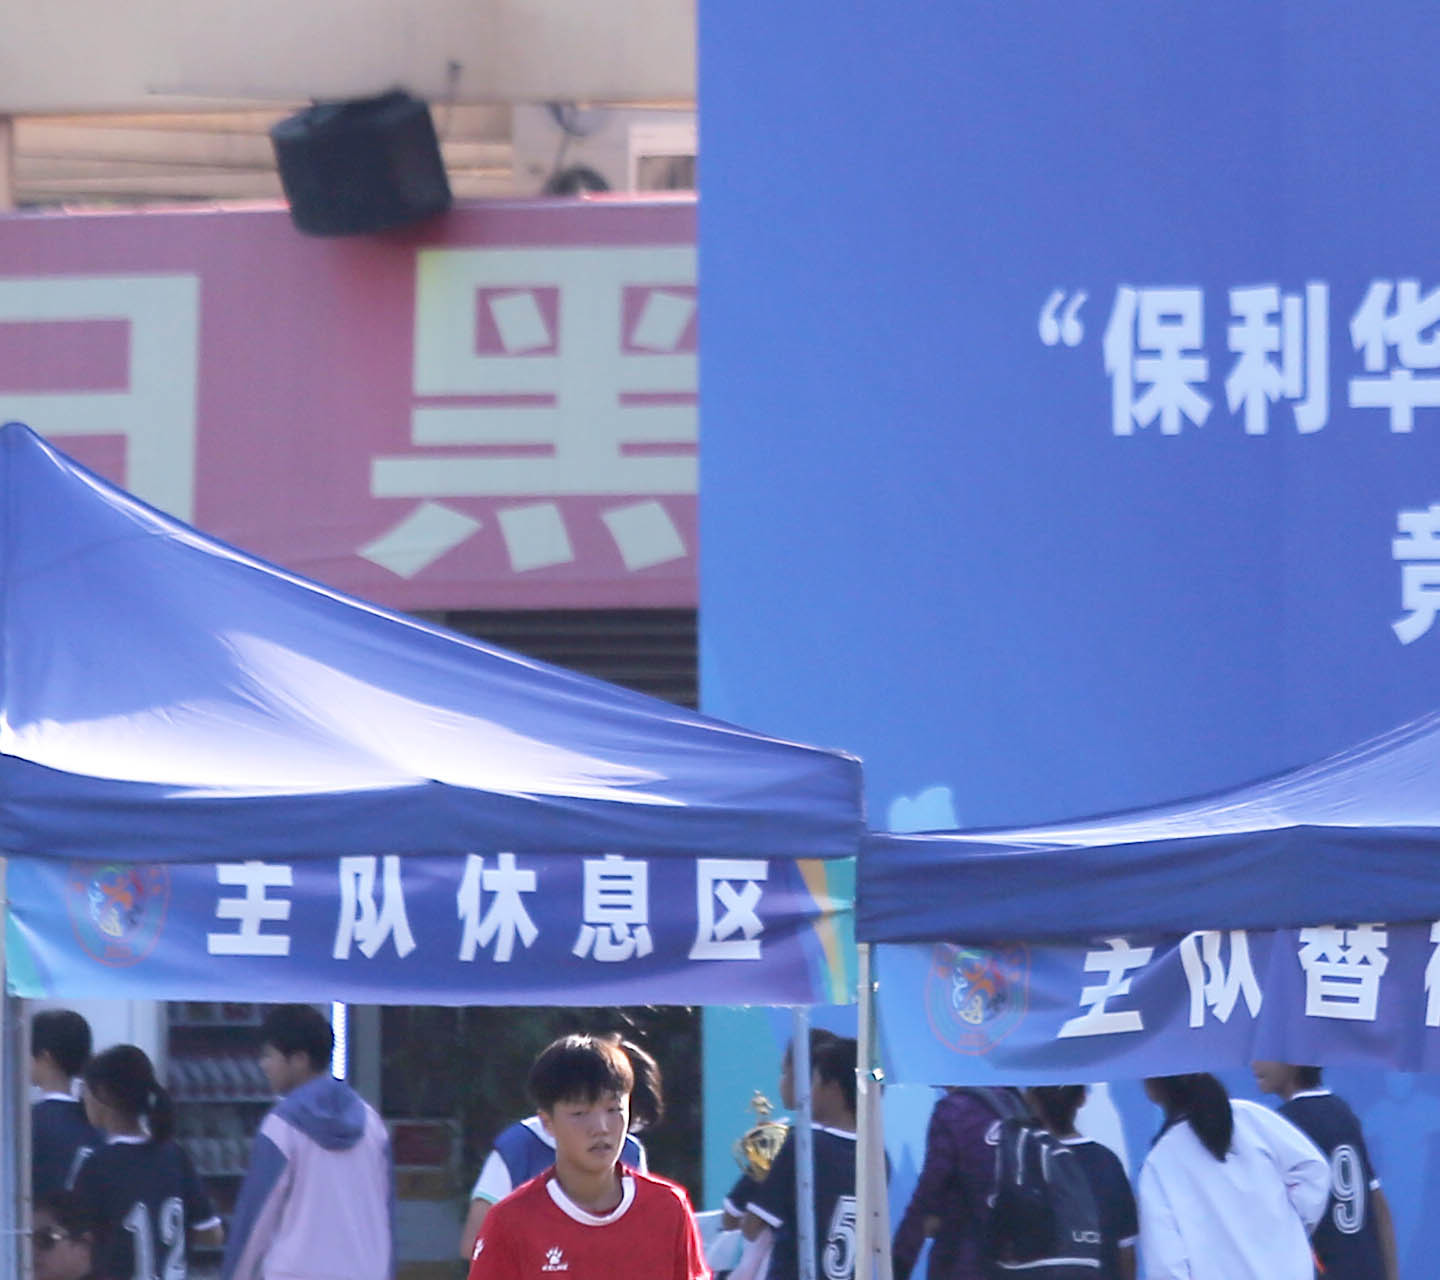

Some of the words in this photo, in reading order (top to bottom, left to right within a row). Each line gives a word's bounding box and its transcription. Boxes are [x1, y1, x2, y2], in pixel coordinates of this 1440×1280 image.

[207, 854, 769, 963] 主队休息区
[1331, 1144, 1364, 1234] 9
